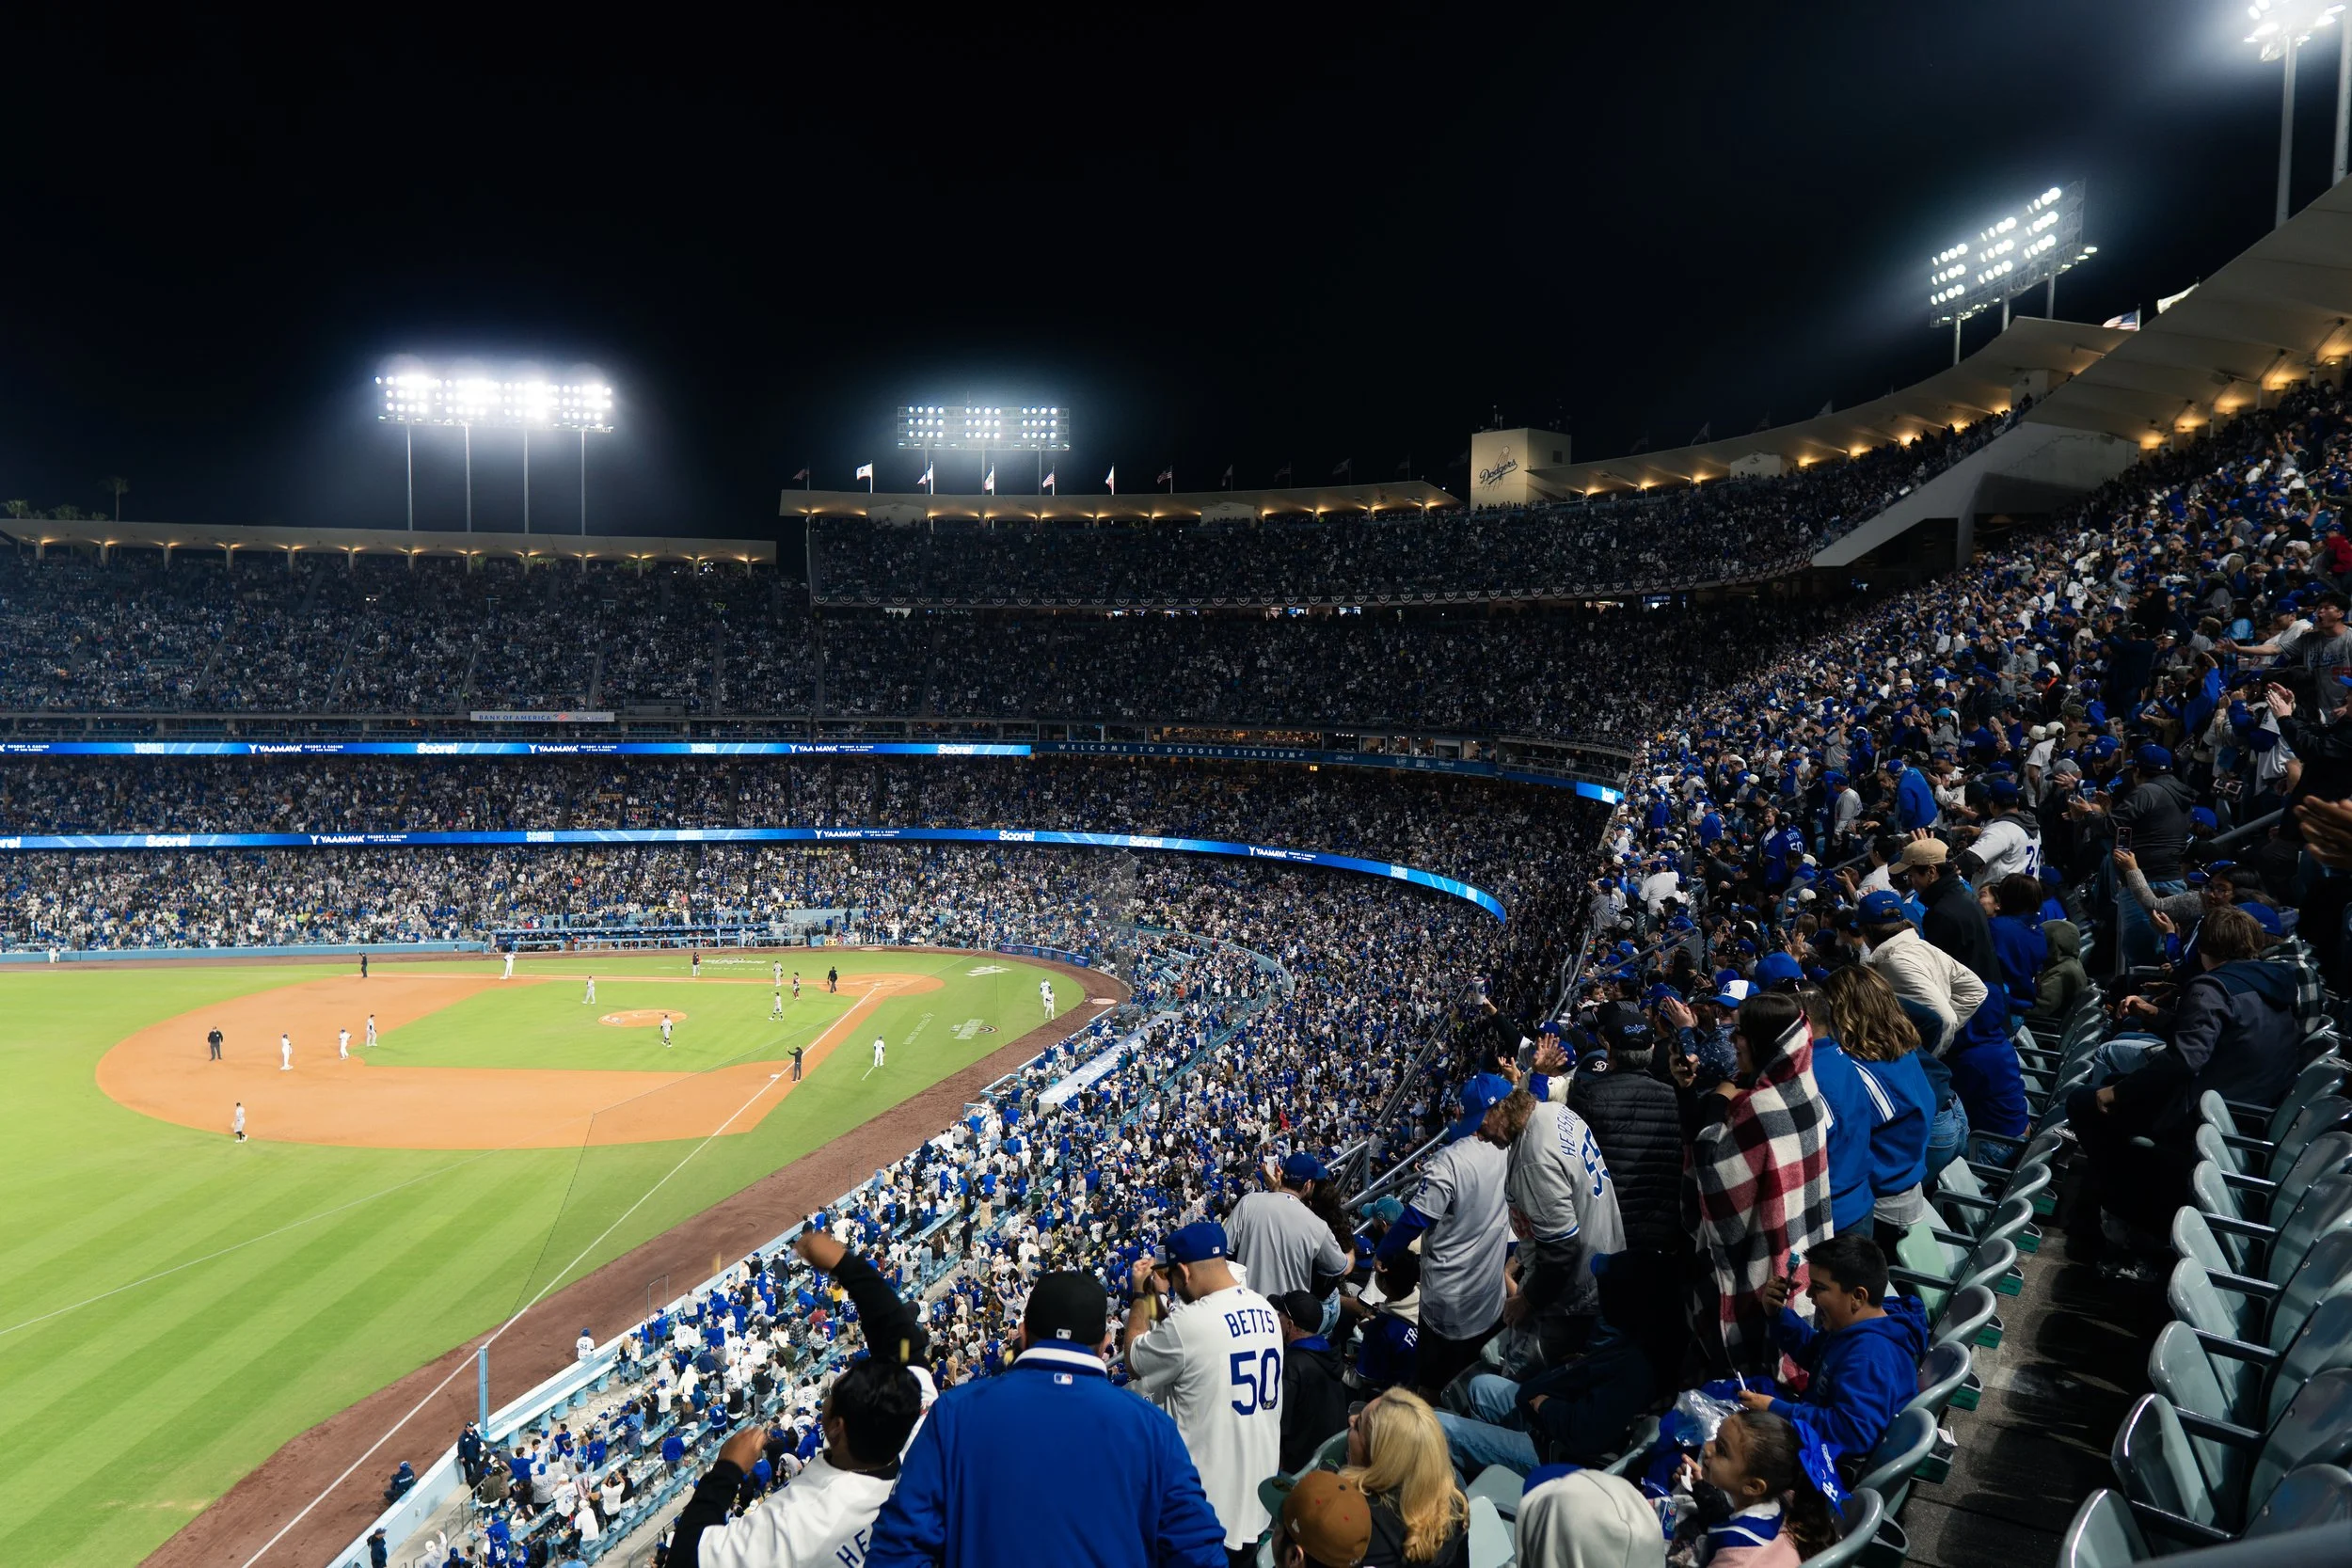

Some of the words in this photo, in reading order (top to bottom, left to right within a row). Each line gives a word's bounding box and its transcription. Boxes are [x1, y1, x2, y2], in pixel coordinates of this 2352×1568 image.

[1479, 458, 1518, 484] Dodgers
[417, 742, 458, 754] Score!
[937, 743, 975, 755] Score!
[1167, 747, 1223, 755] DODGER
[1233, 749, 1295, 758] STADIUM
[145, 834, 191, 847] Score!
[998, 830, 1036, 842] Score!
[1128, 835, 1164, 848] Score!
[1786, 832, 1800, 842] BETTS
[1789, 841, 1804, 855] 50
[1224, 1308, 1275, 1338] BETTS
[1230, 1347, 1280, 1417] 50
[835, 1528, 867, 1568] HE
